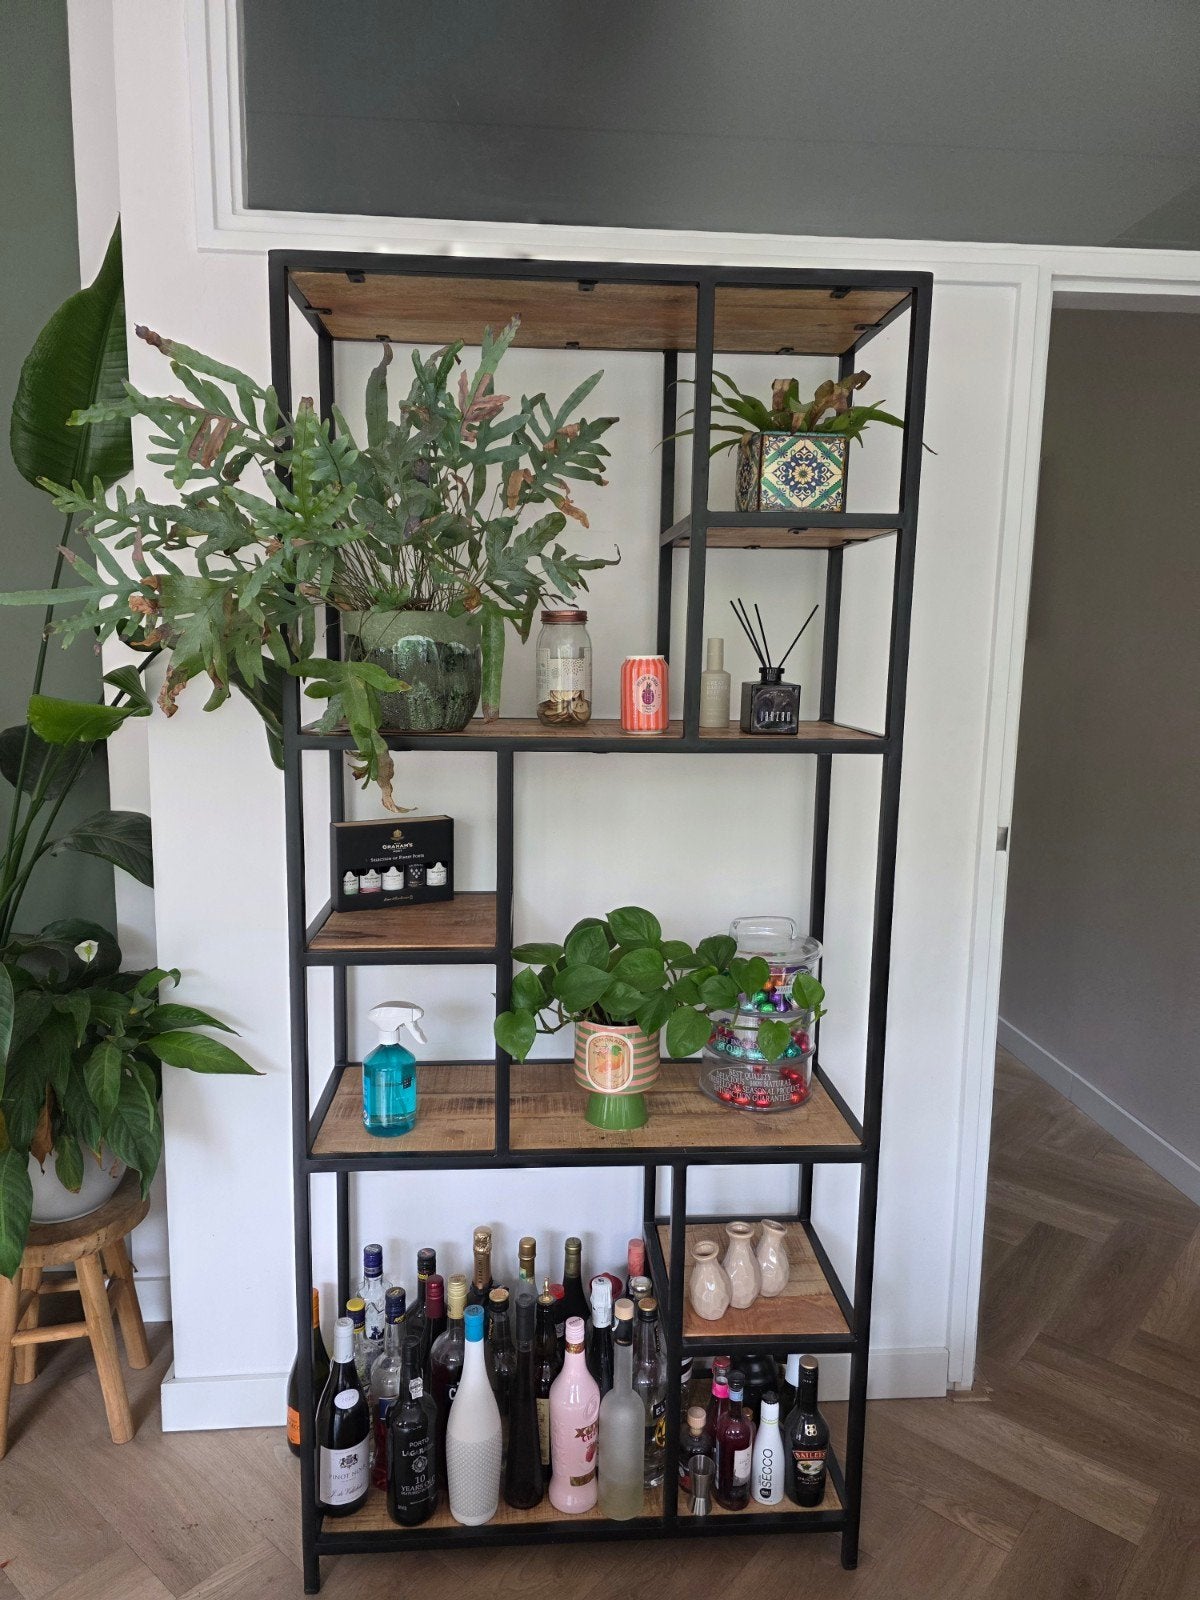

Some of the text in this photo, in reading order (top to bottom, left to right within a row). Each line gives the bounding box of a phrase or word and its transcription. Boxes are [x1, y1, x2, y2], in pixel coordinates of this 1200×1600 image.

[744, 1072, 772, 1081] QUALITY
[763, 1079, 792, 1088] NATURAL
[409, 1437, 430, 1448] PORTO
[761, 1448, 774, 1488] SECCO
[328, 1473, 349, 1481] PINOT
[415, 1474, 426, 1485] 10
[401, 1483, 424, 1492] YEARS
